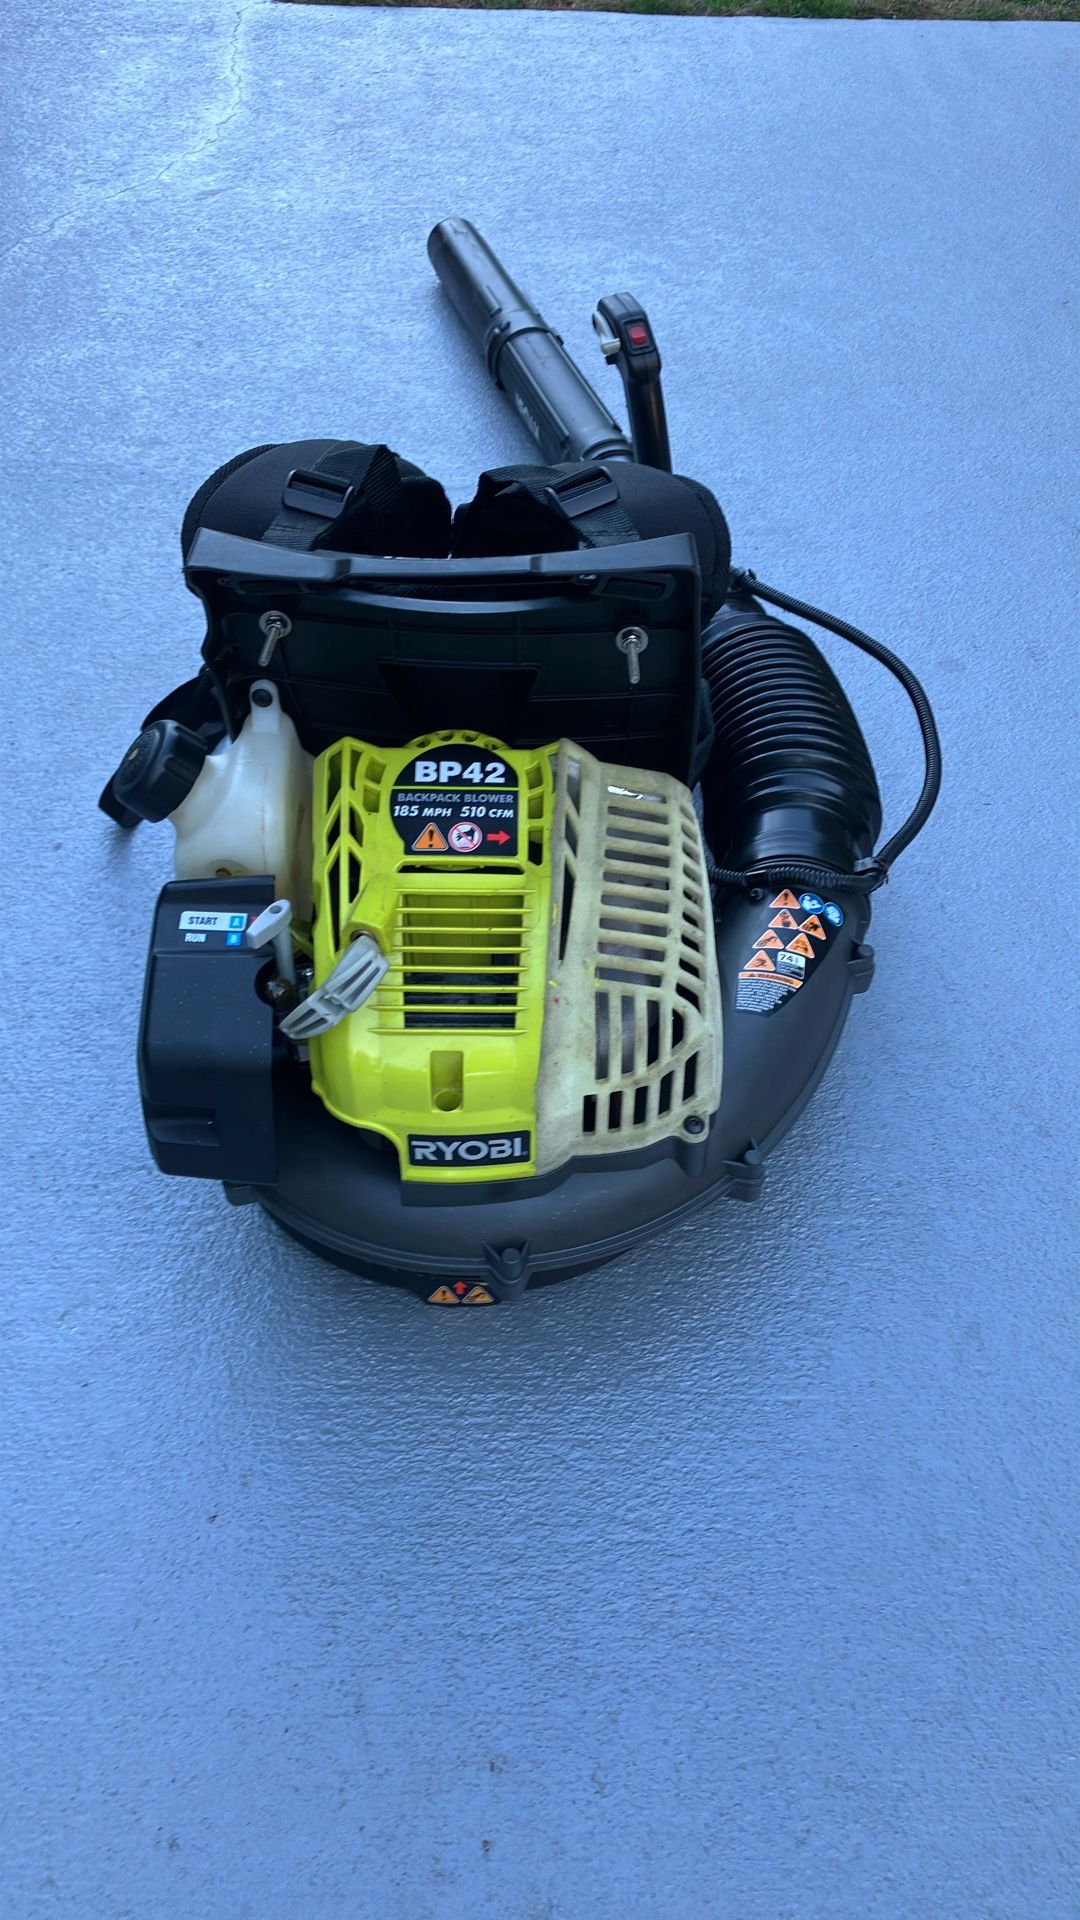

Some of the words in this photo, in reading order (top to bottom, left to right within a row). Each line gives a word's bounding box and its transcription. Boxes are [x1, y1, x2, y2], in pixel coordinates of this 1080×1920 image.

[414, 761, 506, 783] BP42
[397, 793, 460, 803] BACKPACK
[463, 793, 514, 803] BLOWER
[393, 805, 419, 817] 185
[421, 807, 453, 817] MPH
[459, 806, 486, 818] 510
[488, 809, 514, 818] CFM
[188, 916, 218, 925] START
[185, 933, 206, 942] RUN
[410, 1137, 523, 1161] RYOBI
